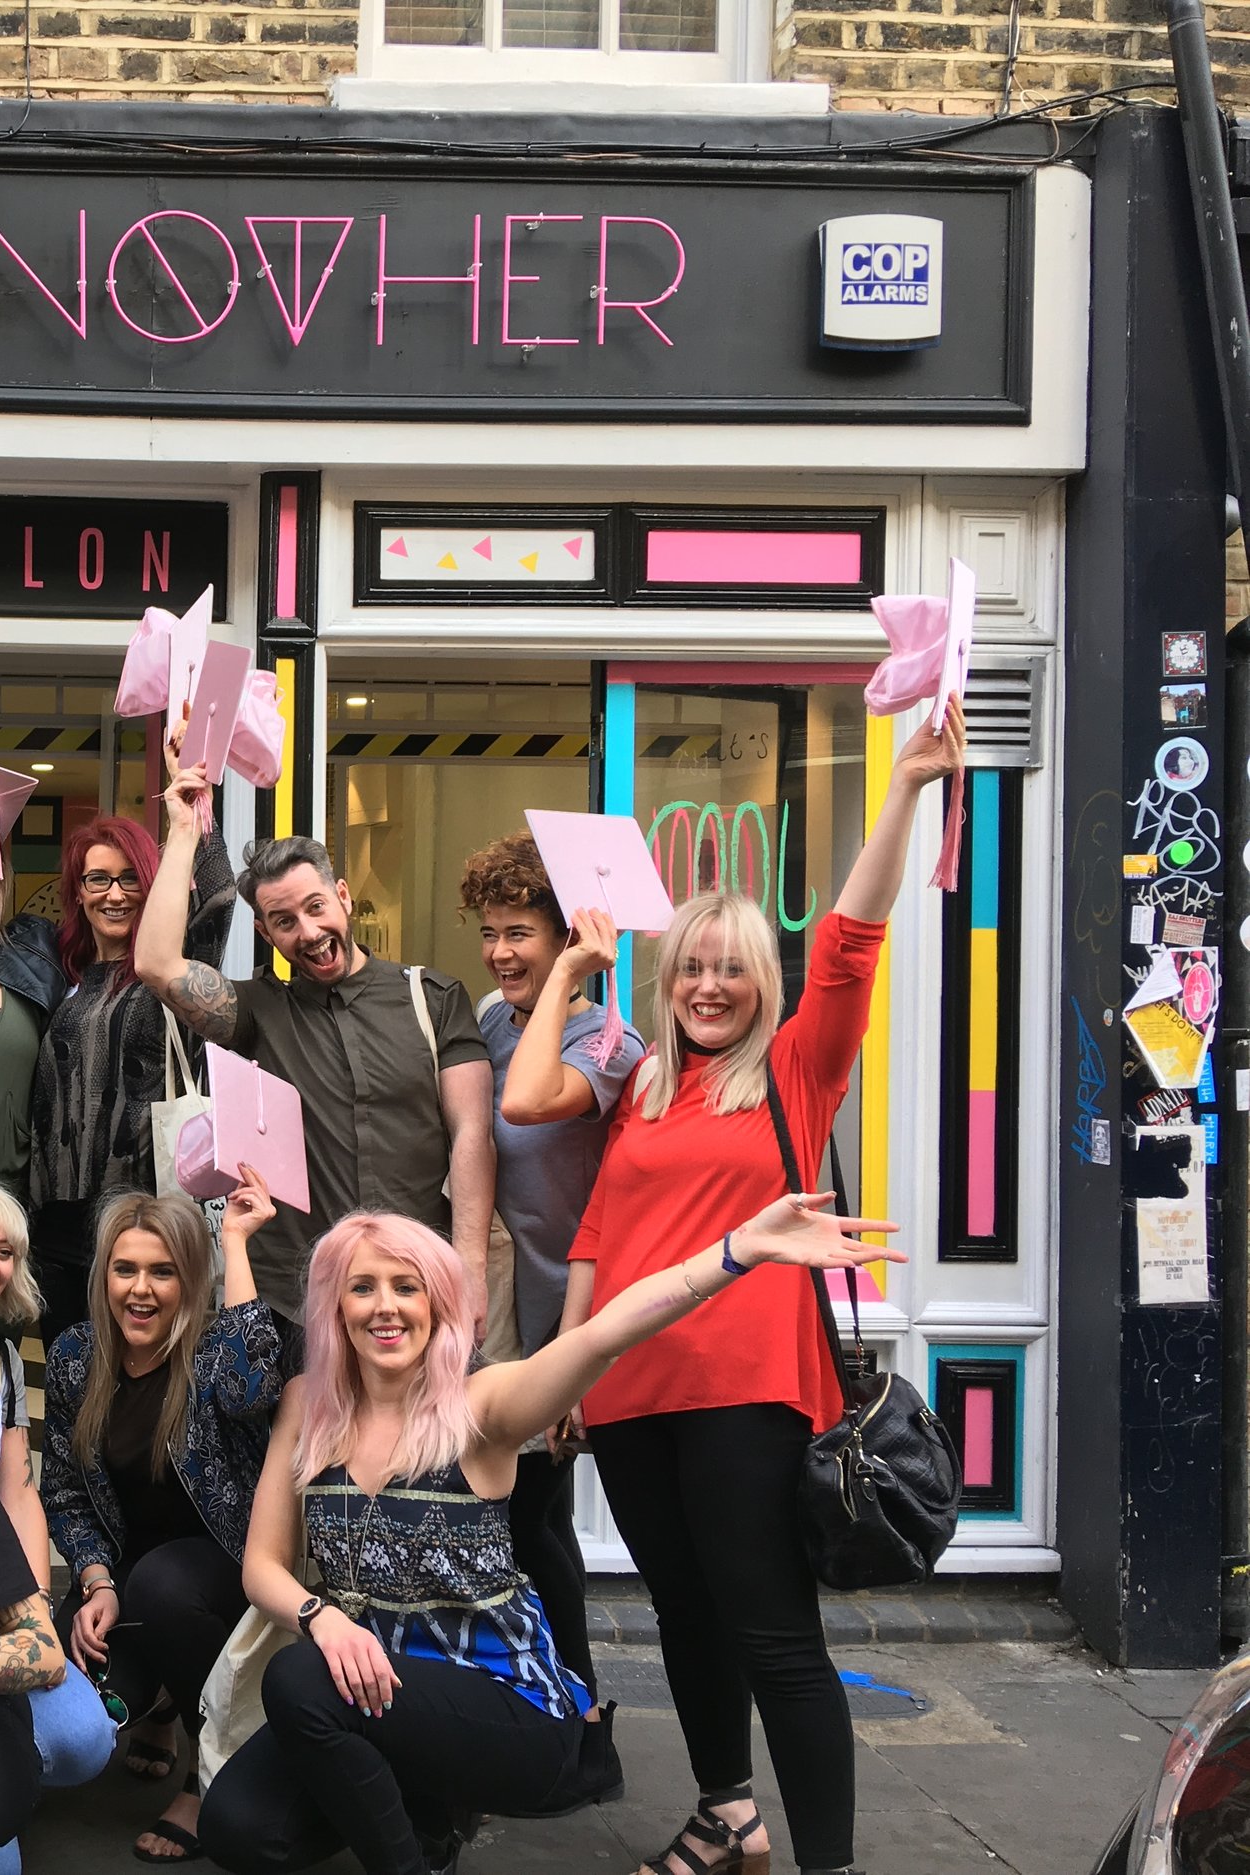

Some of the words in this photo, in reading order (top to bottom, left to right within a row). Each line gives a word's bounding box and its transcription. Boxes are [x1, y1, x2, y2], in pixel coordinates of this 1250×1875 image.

[843, 244, 928, 281] COP
[843, 284, 929, 303] ALARMS
[1170, 1015, 1186, 1029] DO
